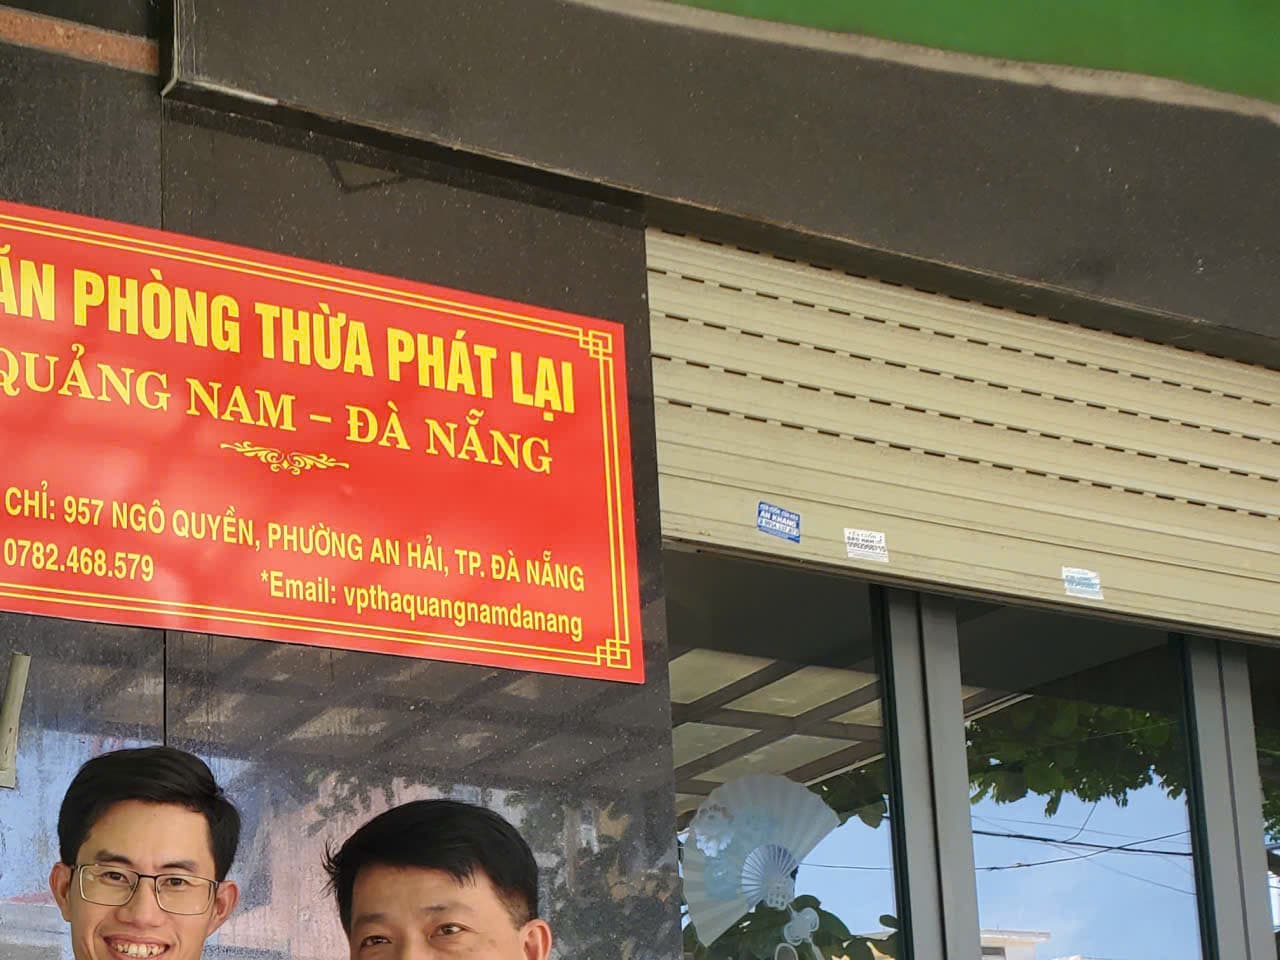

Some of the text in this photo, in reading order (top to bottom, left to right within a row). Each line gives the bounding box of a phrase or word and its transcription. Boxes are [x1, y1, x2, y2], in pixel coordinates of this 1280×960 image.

[71, 268, 241, 354] PHÒNG
[254, 302, 375, 377] THỪA
[386, 327, 498, 399] PHÁT
[510, 351, 575, 422] LẠI
[185, 377, 297, 432] NAM
[345, 400, 411, 450] ĐÀ
[424, 408, 554, 474] NẴNG
[3, 537, 155, 583] 0782.468.579
[5, 479, 55, 520] CHỈ:
[63, 495, 105, 526] 957
[111, 498, 166, 535] NGÔ
[171, 504, 261, 552] QUYỀN,
[267, 521, 364, 561] PHƯỜNG
[369, 537, 401, 566] AN
[407, 534, 449, 577] HẢI,
[453, 548, 486, 578] TP.
[490, 549, 521, 583] ĐÀ
[526, 550, 585, 592] NẴNG
[343, 585, 583, 642] vpthaquangnamdanang
